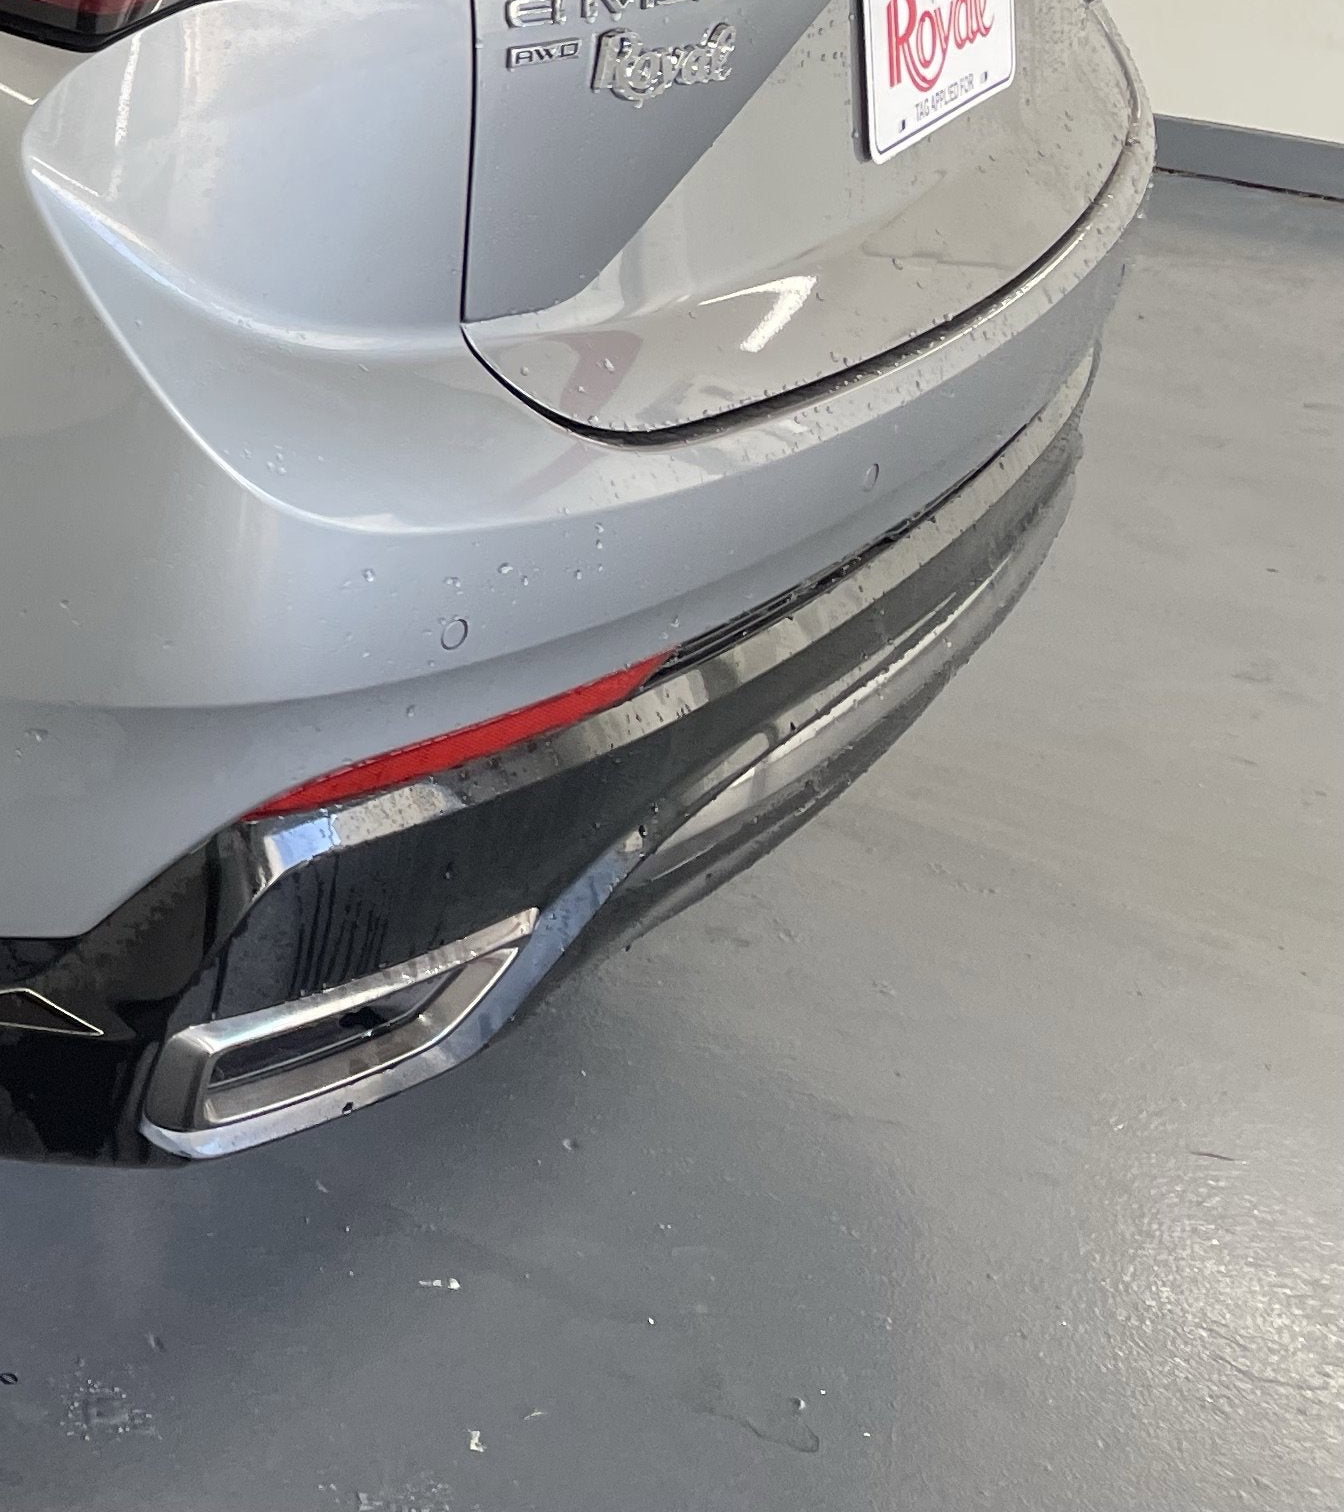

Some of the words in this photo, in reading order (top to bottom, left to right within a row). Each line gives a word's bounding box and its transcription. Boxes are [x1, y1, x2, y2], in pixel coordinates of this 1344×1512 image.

[512, 41, 580, 67] AWD
[591, 22, 737, 107] Royal
[915, 97, 930, 122] TAG
[931, 81, 960, 112] APPLIED
[960, 73, 974, 96] FOR
